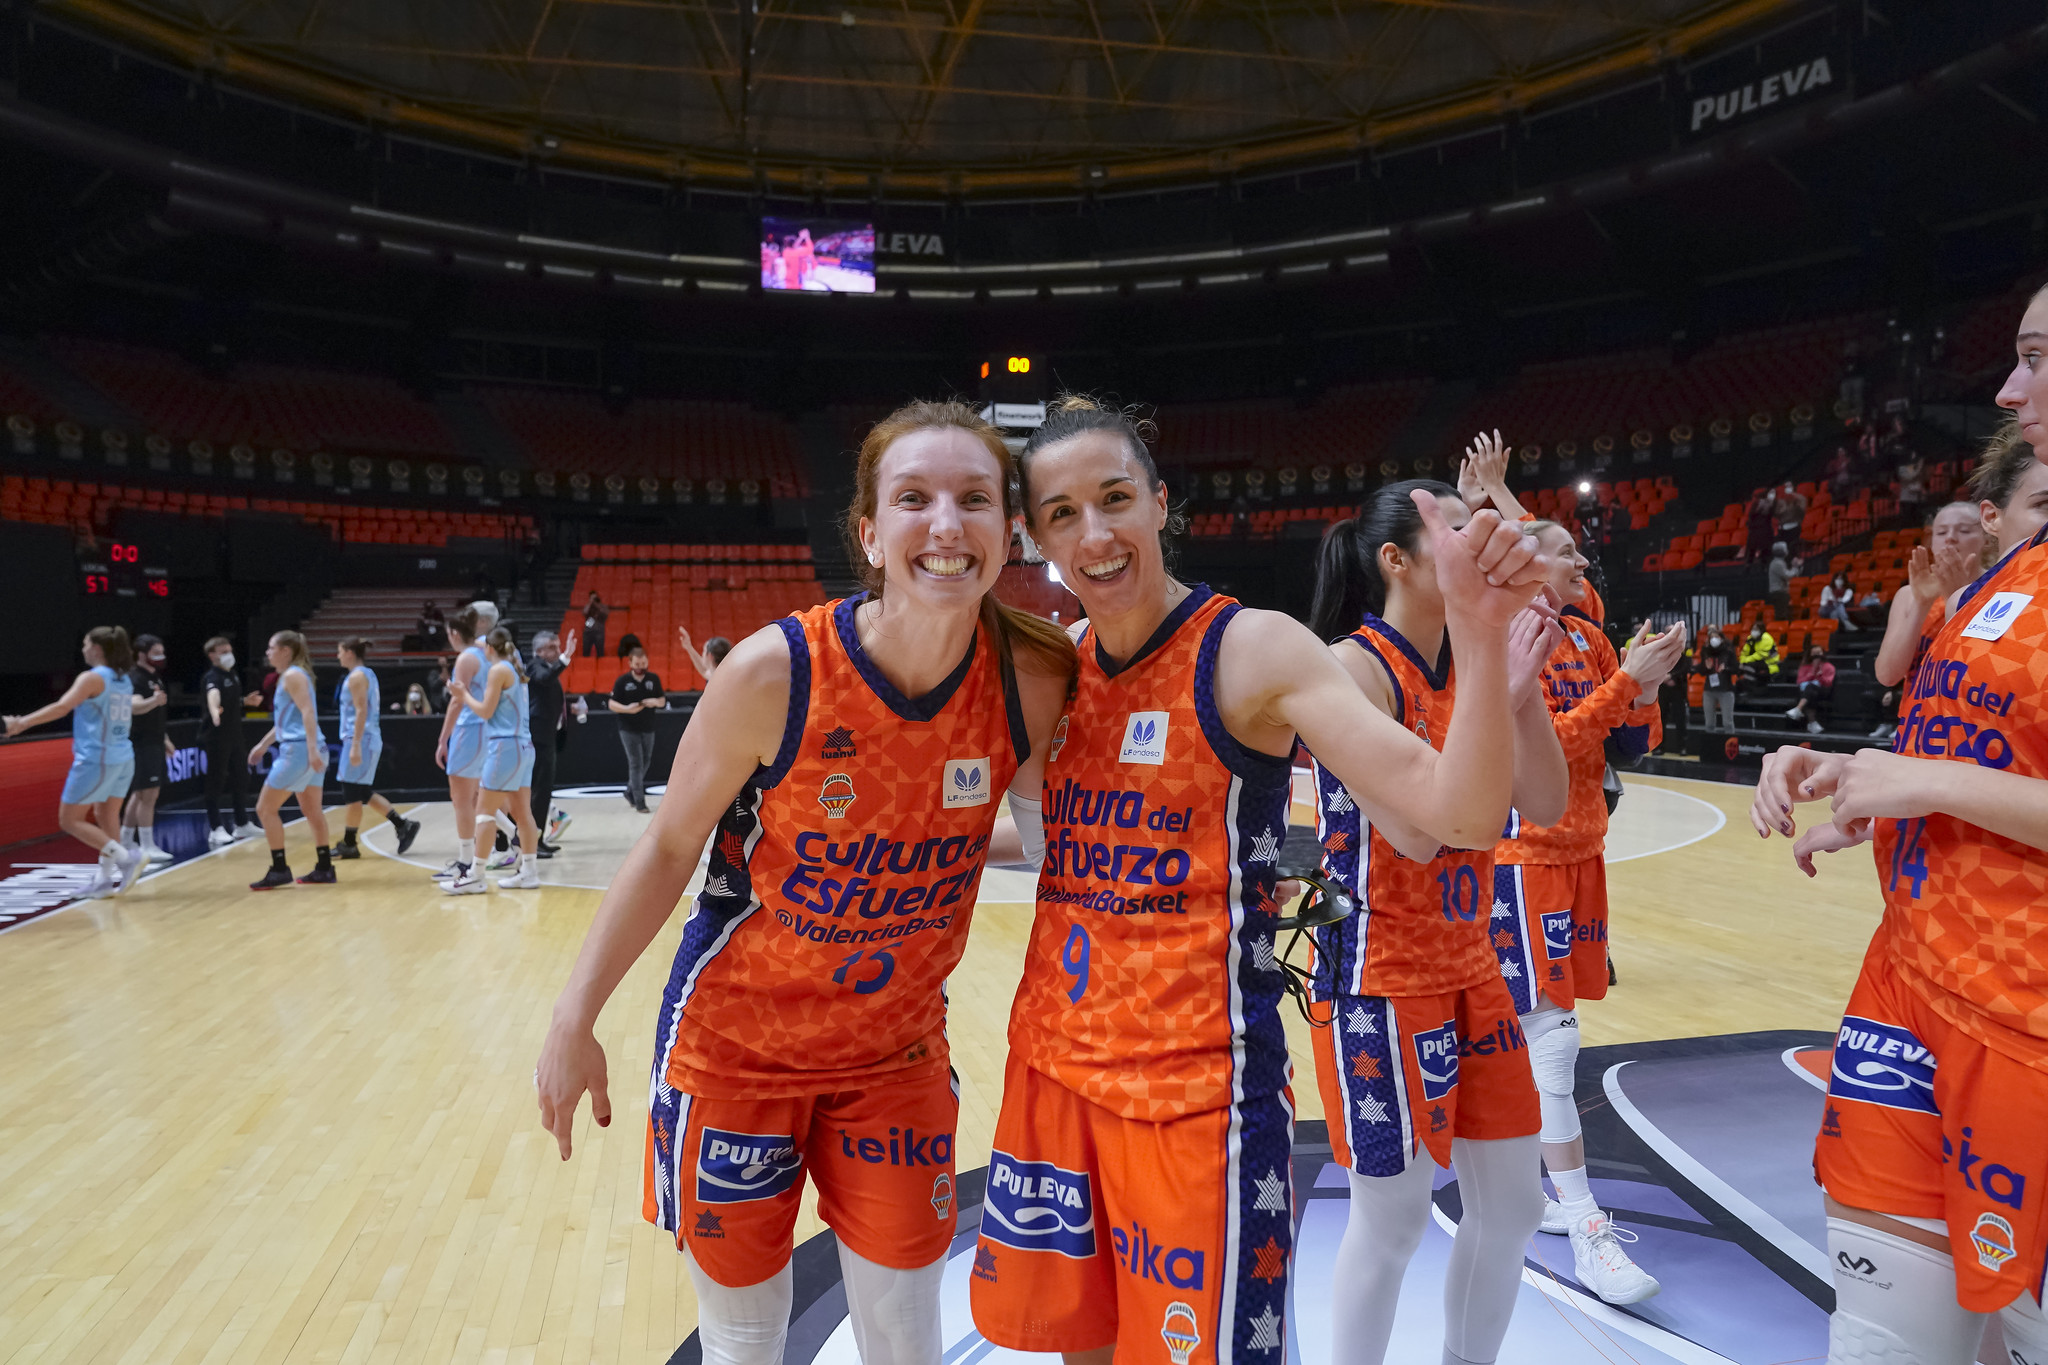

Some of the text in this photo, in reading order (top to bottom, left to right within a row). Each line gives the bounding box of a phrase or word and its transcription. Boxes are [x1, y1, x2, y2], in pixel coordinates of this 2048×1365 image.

[1691, 57, 1832, 131] PULEVA
[1008, 357, 1030, 373] 00
[86, 575, 109, 593] 57
[148, 580, 169, 596] 46
[1966, 682, 2016, 717] del
[821, 749, 857, 759] luanvi
[1133, 749, 1160, 757] endesa
[1147, 805, 1193, 833] del
[795, 831, 969, 876] Cultura
[1045, 828, 1191, 887] sfuerzo
[1889, 817, 1929, 899] 14
[1436, 864, 1479, 922] 10
[831, 941, 904, 995] 15
[1062, 923, 1092, 1005] 9
[1458, 1018, 1528, 1058] teik
[838, 1126, 953, 1167] teika
[992, 1162, 1084, 1209] PULEVA
[694, 1230, 725, 1239] luanvi
